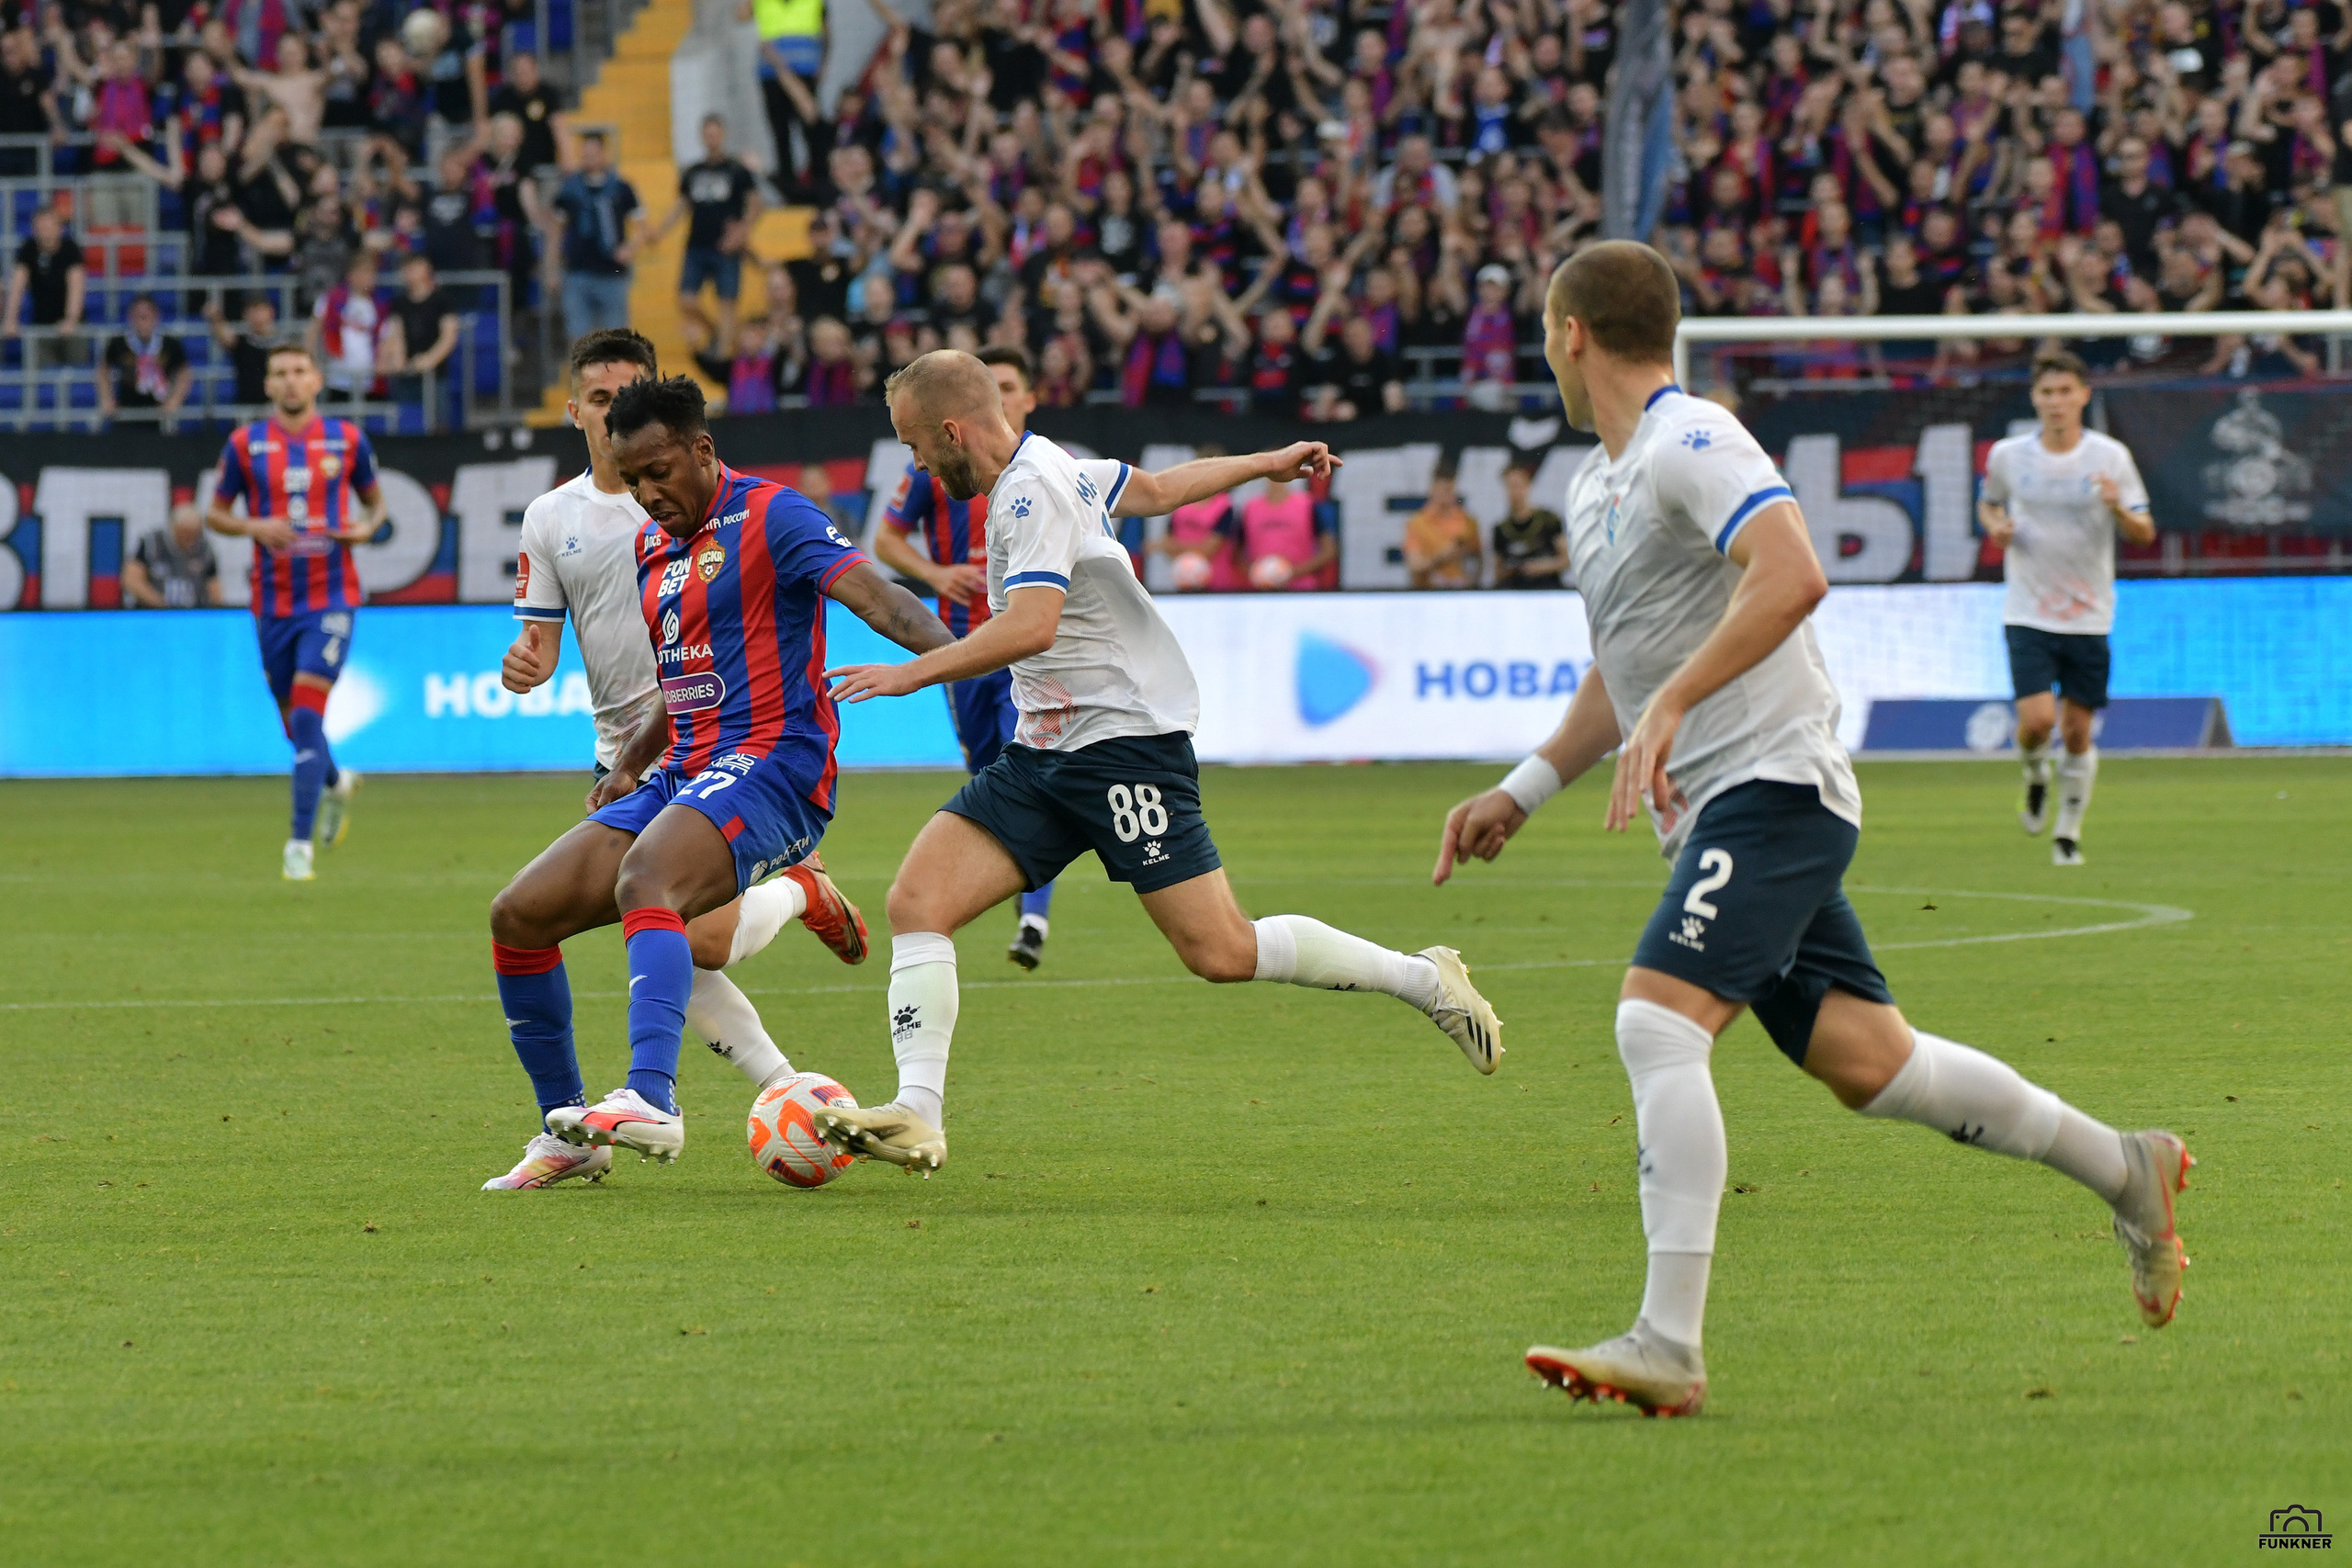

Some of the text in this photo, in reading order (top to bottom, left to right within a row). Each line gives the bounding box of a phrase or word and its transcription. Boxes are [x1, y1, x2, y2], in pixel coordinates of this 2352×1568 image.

[723, 508, 750, 526] РОССИИ
[561, 547, 582, 558] KELME
[698, 550, 723, 566] ЦСКА
[662, 556, 693, 579] FON
[657, 573, 690, 598] BET
[1415, 658, 1594, 701] НОВА
[675, 770, 738, 800] 27
[1107, 784, 1169, 842] 88
[1142, 853, 1170, 866] KELME
[1683, 847, 1734, 921] 2
[892, 1021, 922, 1038] KELME
